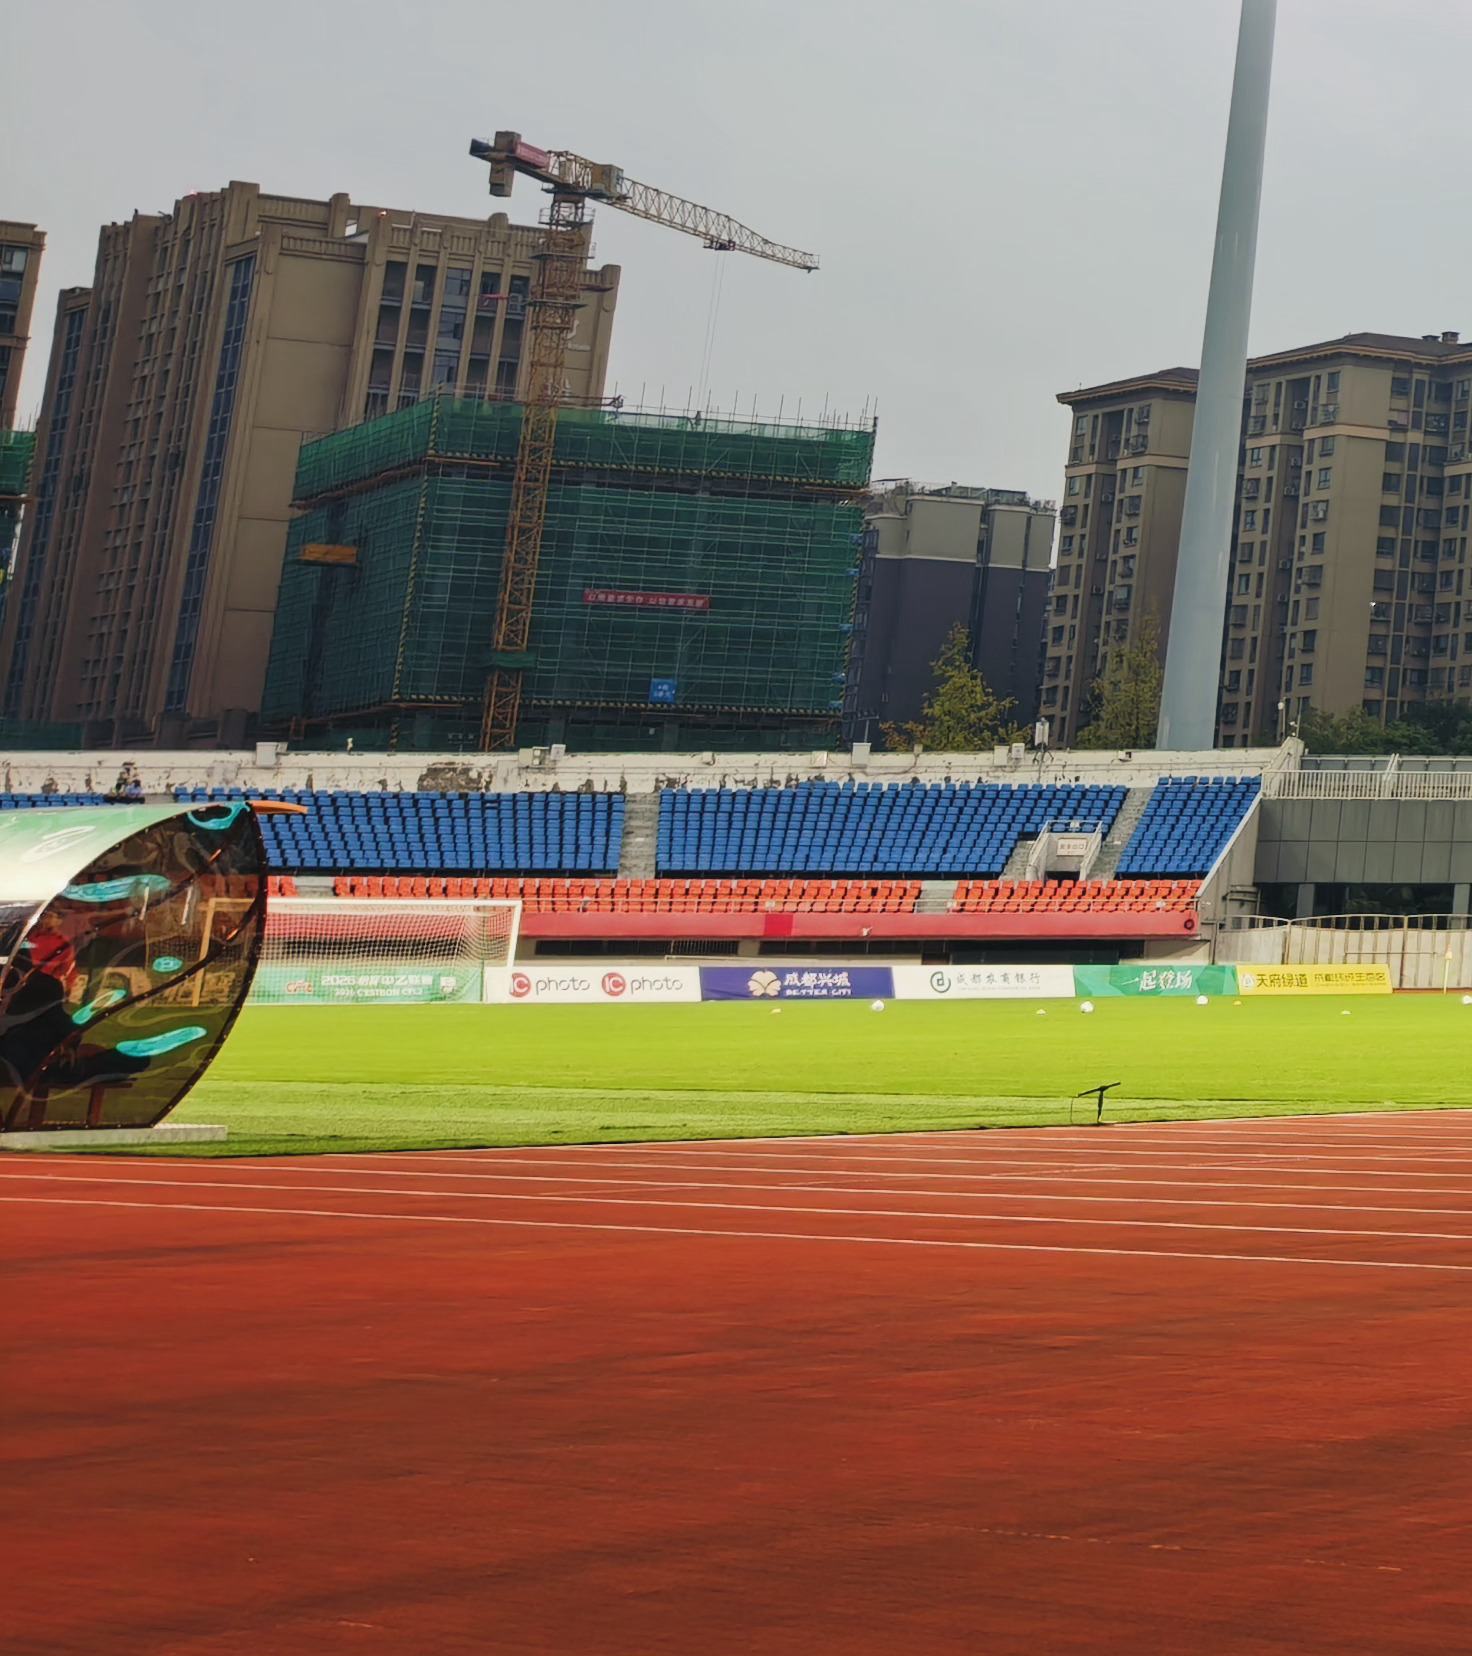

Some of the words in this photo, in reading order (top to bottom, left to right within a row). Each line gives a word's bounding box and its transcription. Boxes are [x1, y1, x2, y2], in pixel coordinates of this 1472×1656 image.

[536, 976, 590, 994] photo
[631, 976, 683, 994] photo
[784, 971, 851, 989] 成都兴城
[1120, 969, 1193, 992] 一起登场
[1256, 973, 1309, 988] 天府绿道
